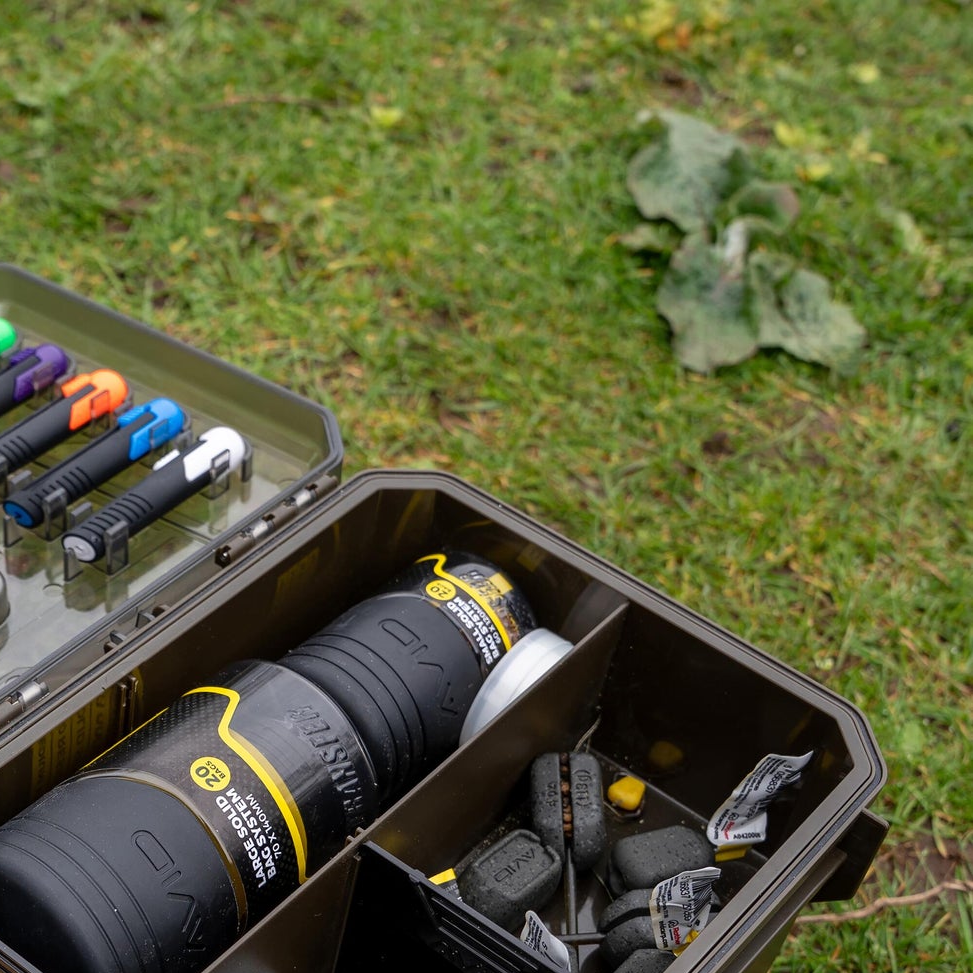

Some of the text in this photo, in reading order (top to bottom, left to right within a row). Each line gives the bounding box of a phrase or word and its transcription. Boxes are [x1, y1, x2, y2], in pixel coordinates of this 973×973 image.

[430, 585, 449, 598] 20
[446, 601, 474, 629] SOLID
[452, 596, 488, 637] SYSTEM
[472, 625, 494, 665] SMALL
[486, 635, 500, 659] BAG
[378, 618, 458, 716] AVID
[195, 765, 221, 788] 20
[205, 760, 226, 779] BAGS
[215, 796, 267, 888] LARGE SOLID
[225, 787, 277, 880] BAG SYSTEM
[245, 793, 283, 859] 70 X 140MM
[494, 847, 536, 883] AVID
[130, 829, 207, 952] AVID
